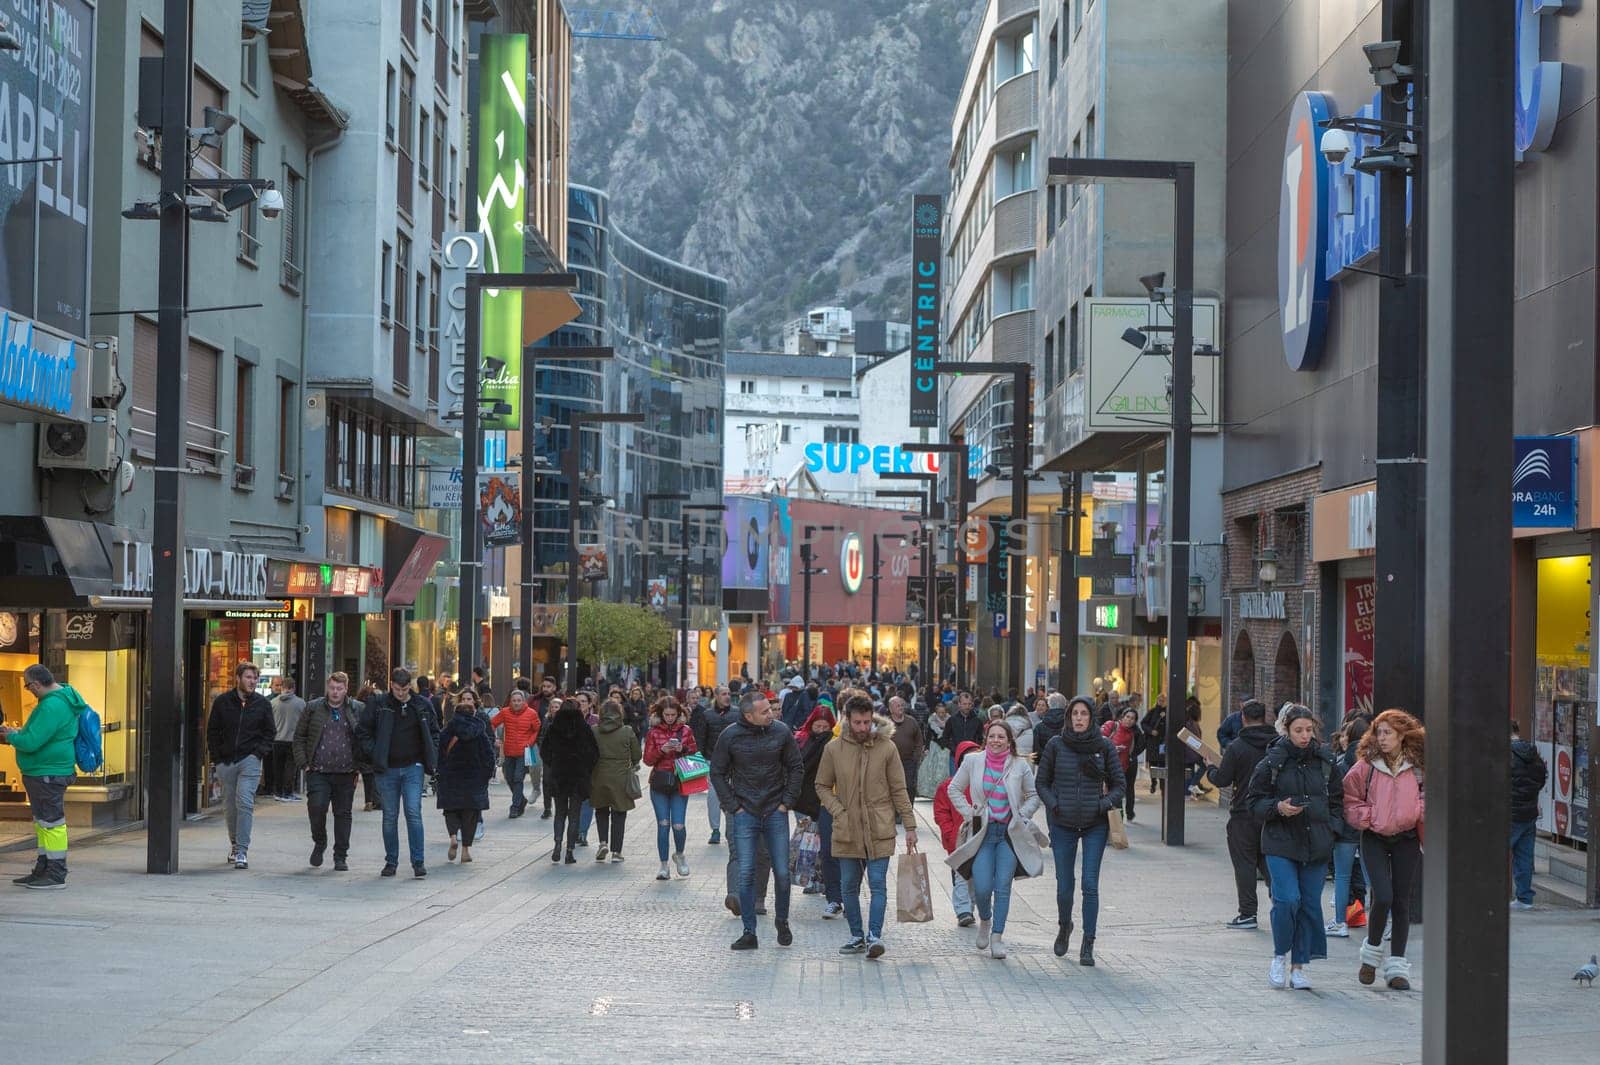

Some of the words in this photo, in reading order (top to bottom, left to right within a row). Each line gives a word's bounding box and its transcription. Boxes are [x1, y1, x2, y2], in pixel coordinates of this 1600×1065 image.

[57, 55, 81, 105] 2022
[805, 442, 913, 474] SUPER
[1533, 503, 1557, 516] 24h
[995, 613, 1005, 627] P
